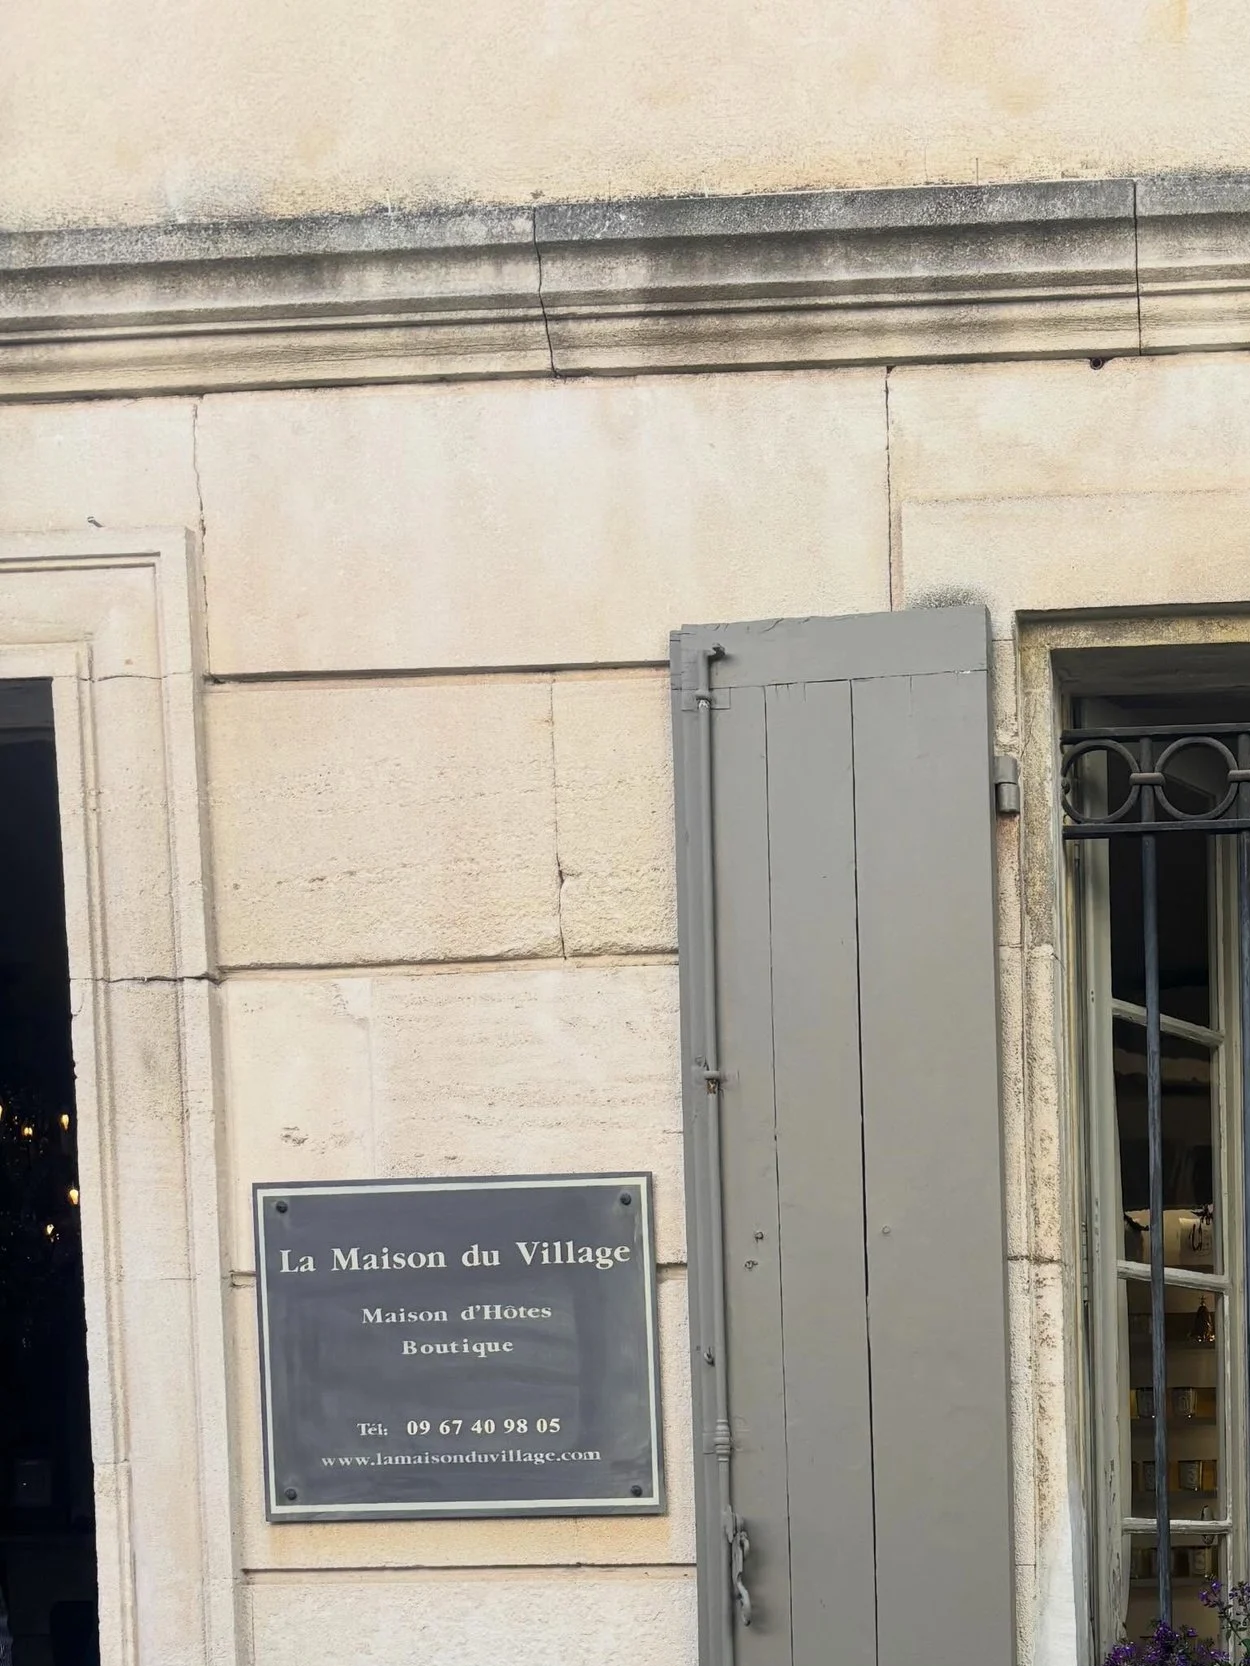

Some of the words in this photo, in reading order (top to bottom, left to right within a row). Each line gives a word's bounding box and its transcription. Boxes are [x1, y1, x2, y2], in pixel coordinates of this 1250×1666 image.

[279, 1249, 317, 1273] La
[331, 1246, 447, 1272] Maison
[461, 1243, 501, 1267] du
[515, 1240, 631, 1270] Village
[361, 1308, 448, 1324] Maison
[460, 1304, 552, 1321] d'Hôtes
[402, 1338, 514, 1358] Boutique
[356, 1422, 389, 1436] Tél:
[406, 1420, 431, 1436] 09
[439, 1419, 463, 1435] 67
[470, 1419, 496, 1434] 40
[503, 1418, 528, 1434] 98
[536, 1418, 561, 1433] 05
[321, 1449, 601, 1467] www.lamaisonduvillage.com
